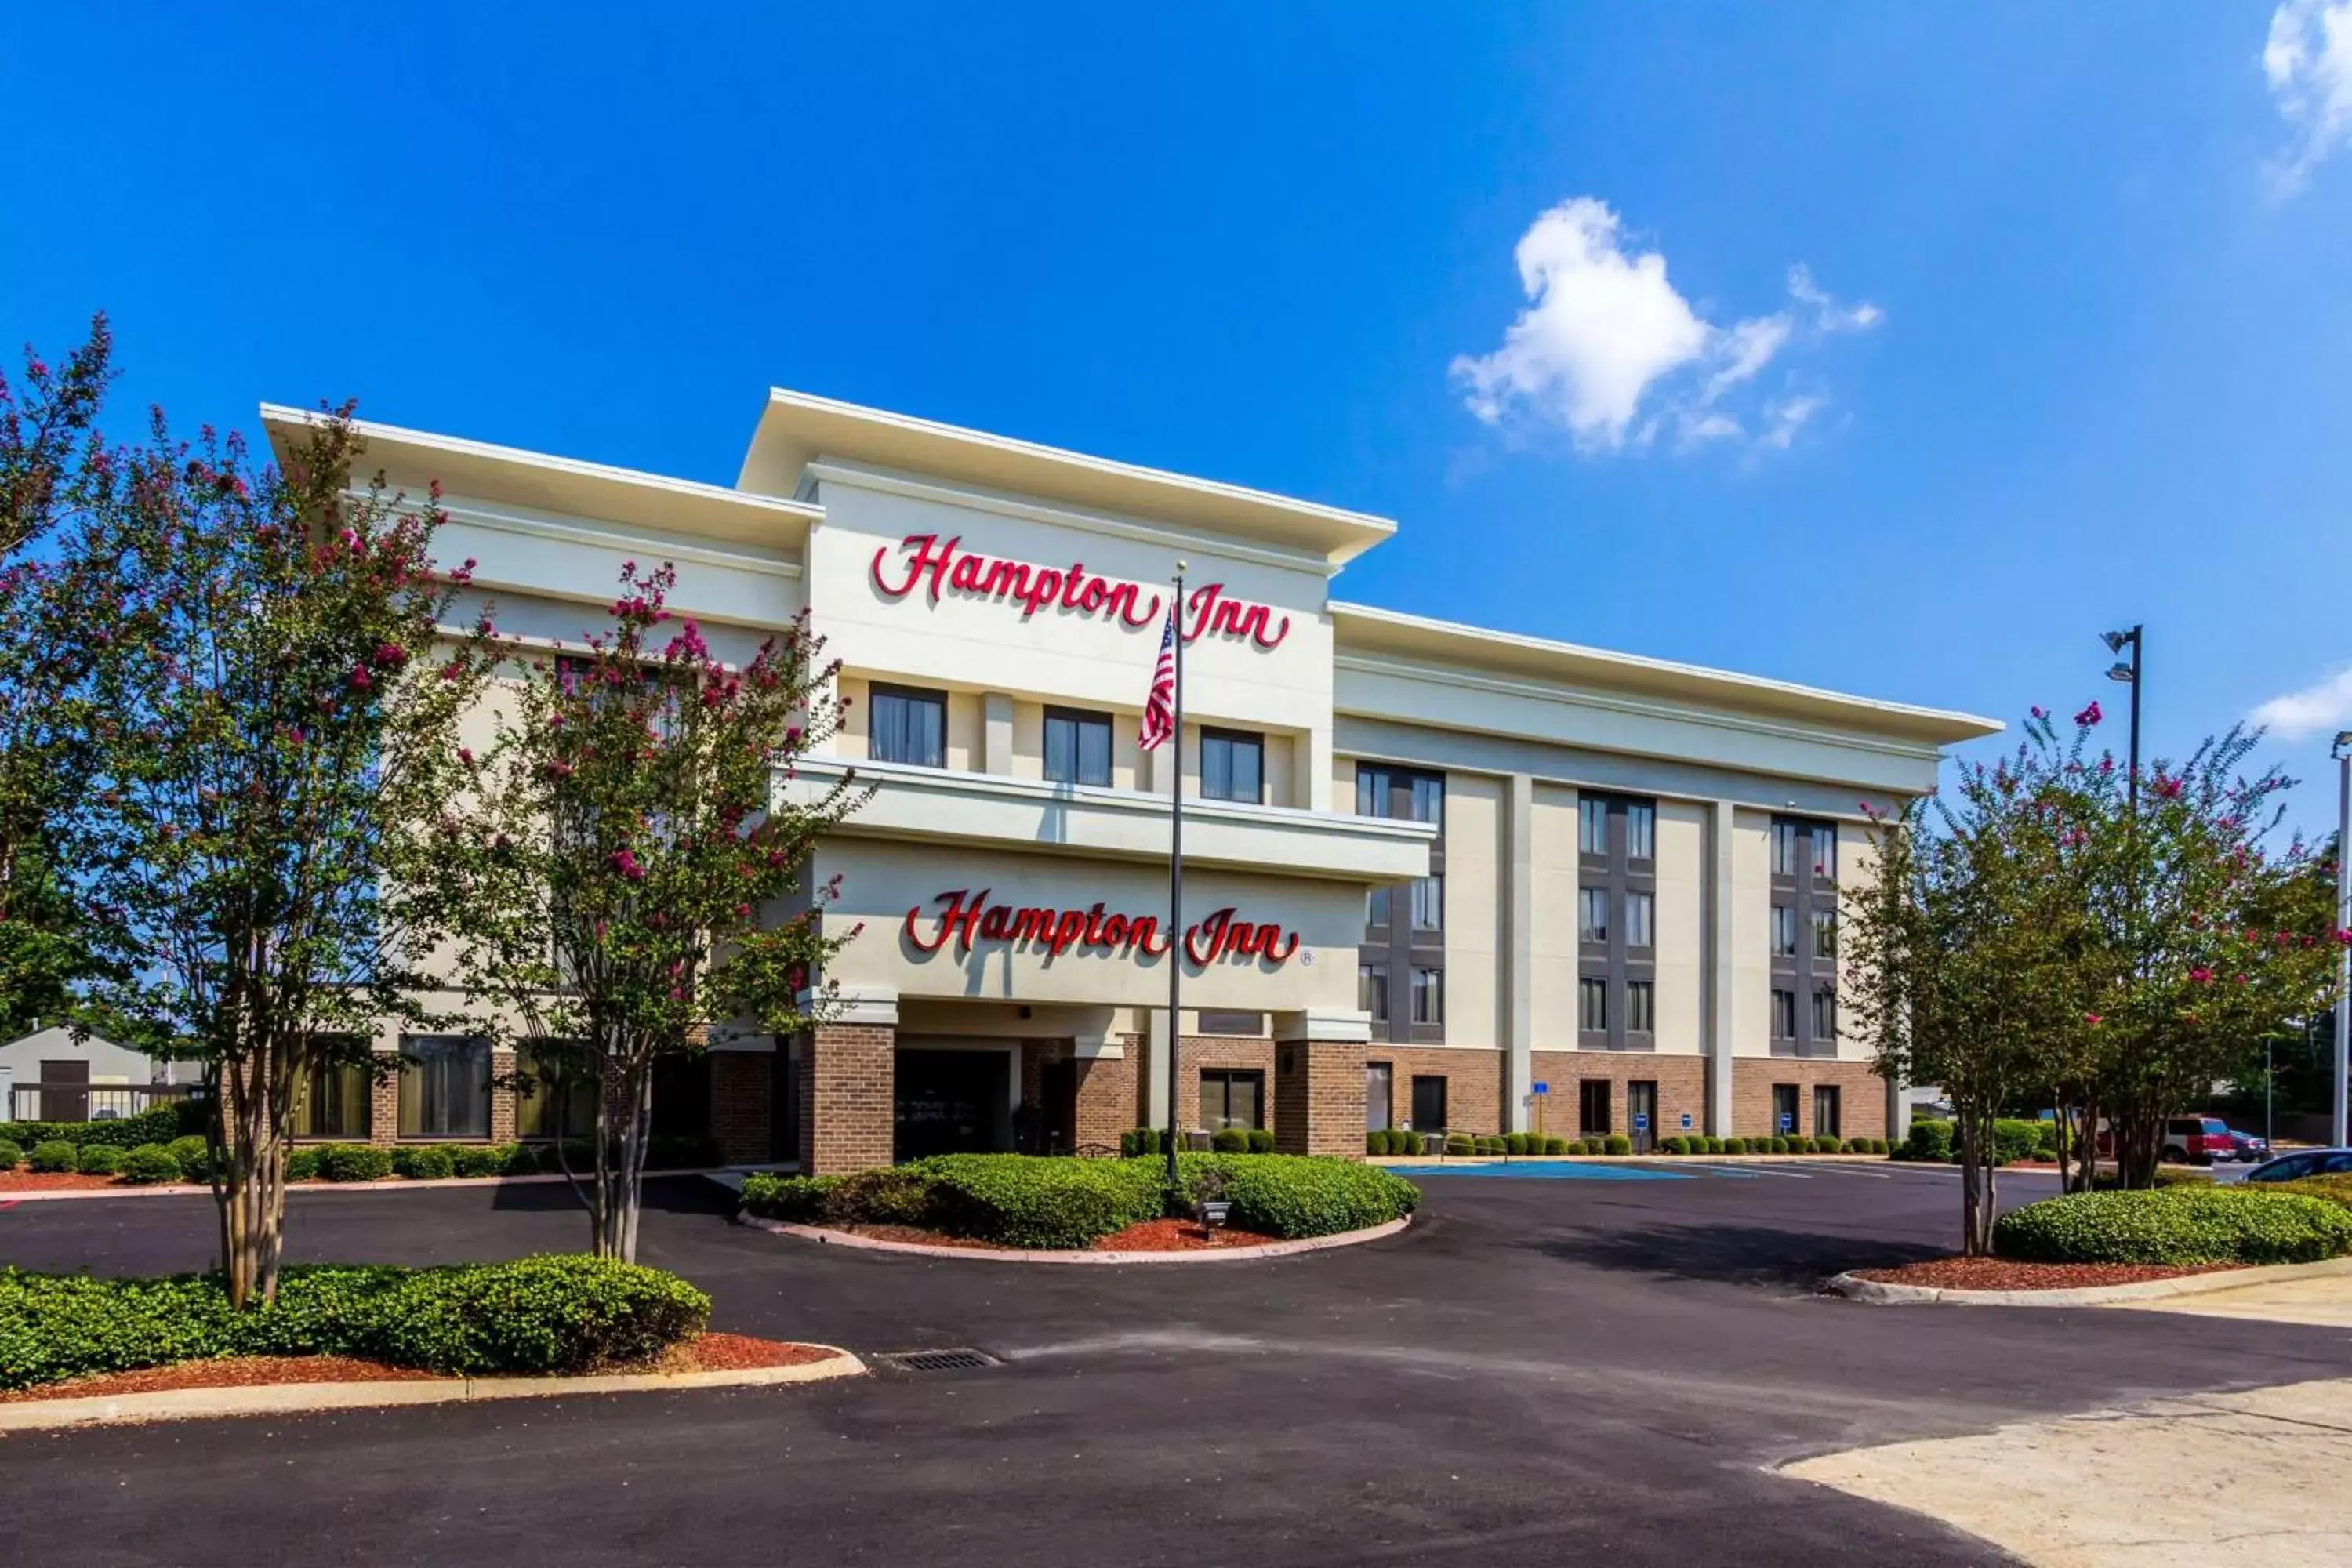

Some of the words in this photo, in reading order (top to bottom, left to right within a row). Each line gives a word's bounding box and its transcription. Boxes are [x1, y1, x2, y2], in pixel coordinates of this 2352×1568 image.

[873, 533, 1160, 627] Hampton
[1174, 583, 1290, 648] Inn
[906, 888, 1174, 957] Hampton
[1185, 907, 1299, 967] Inn
